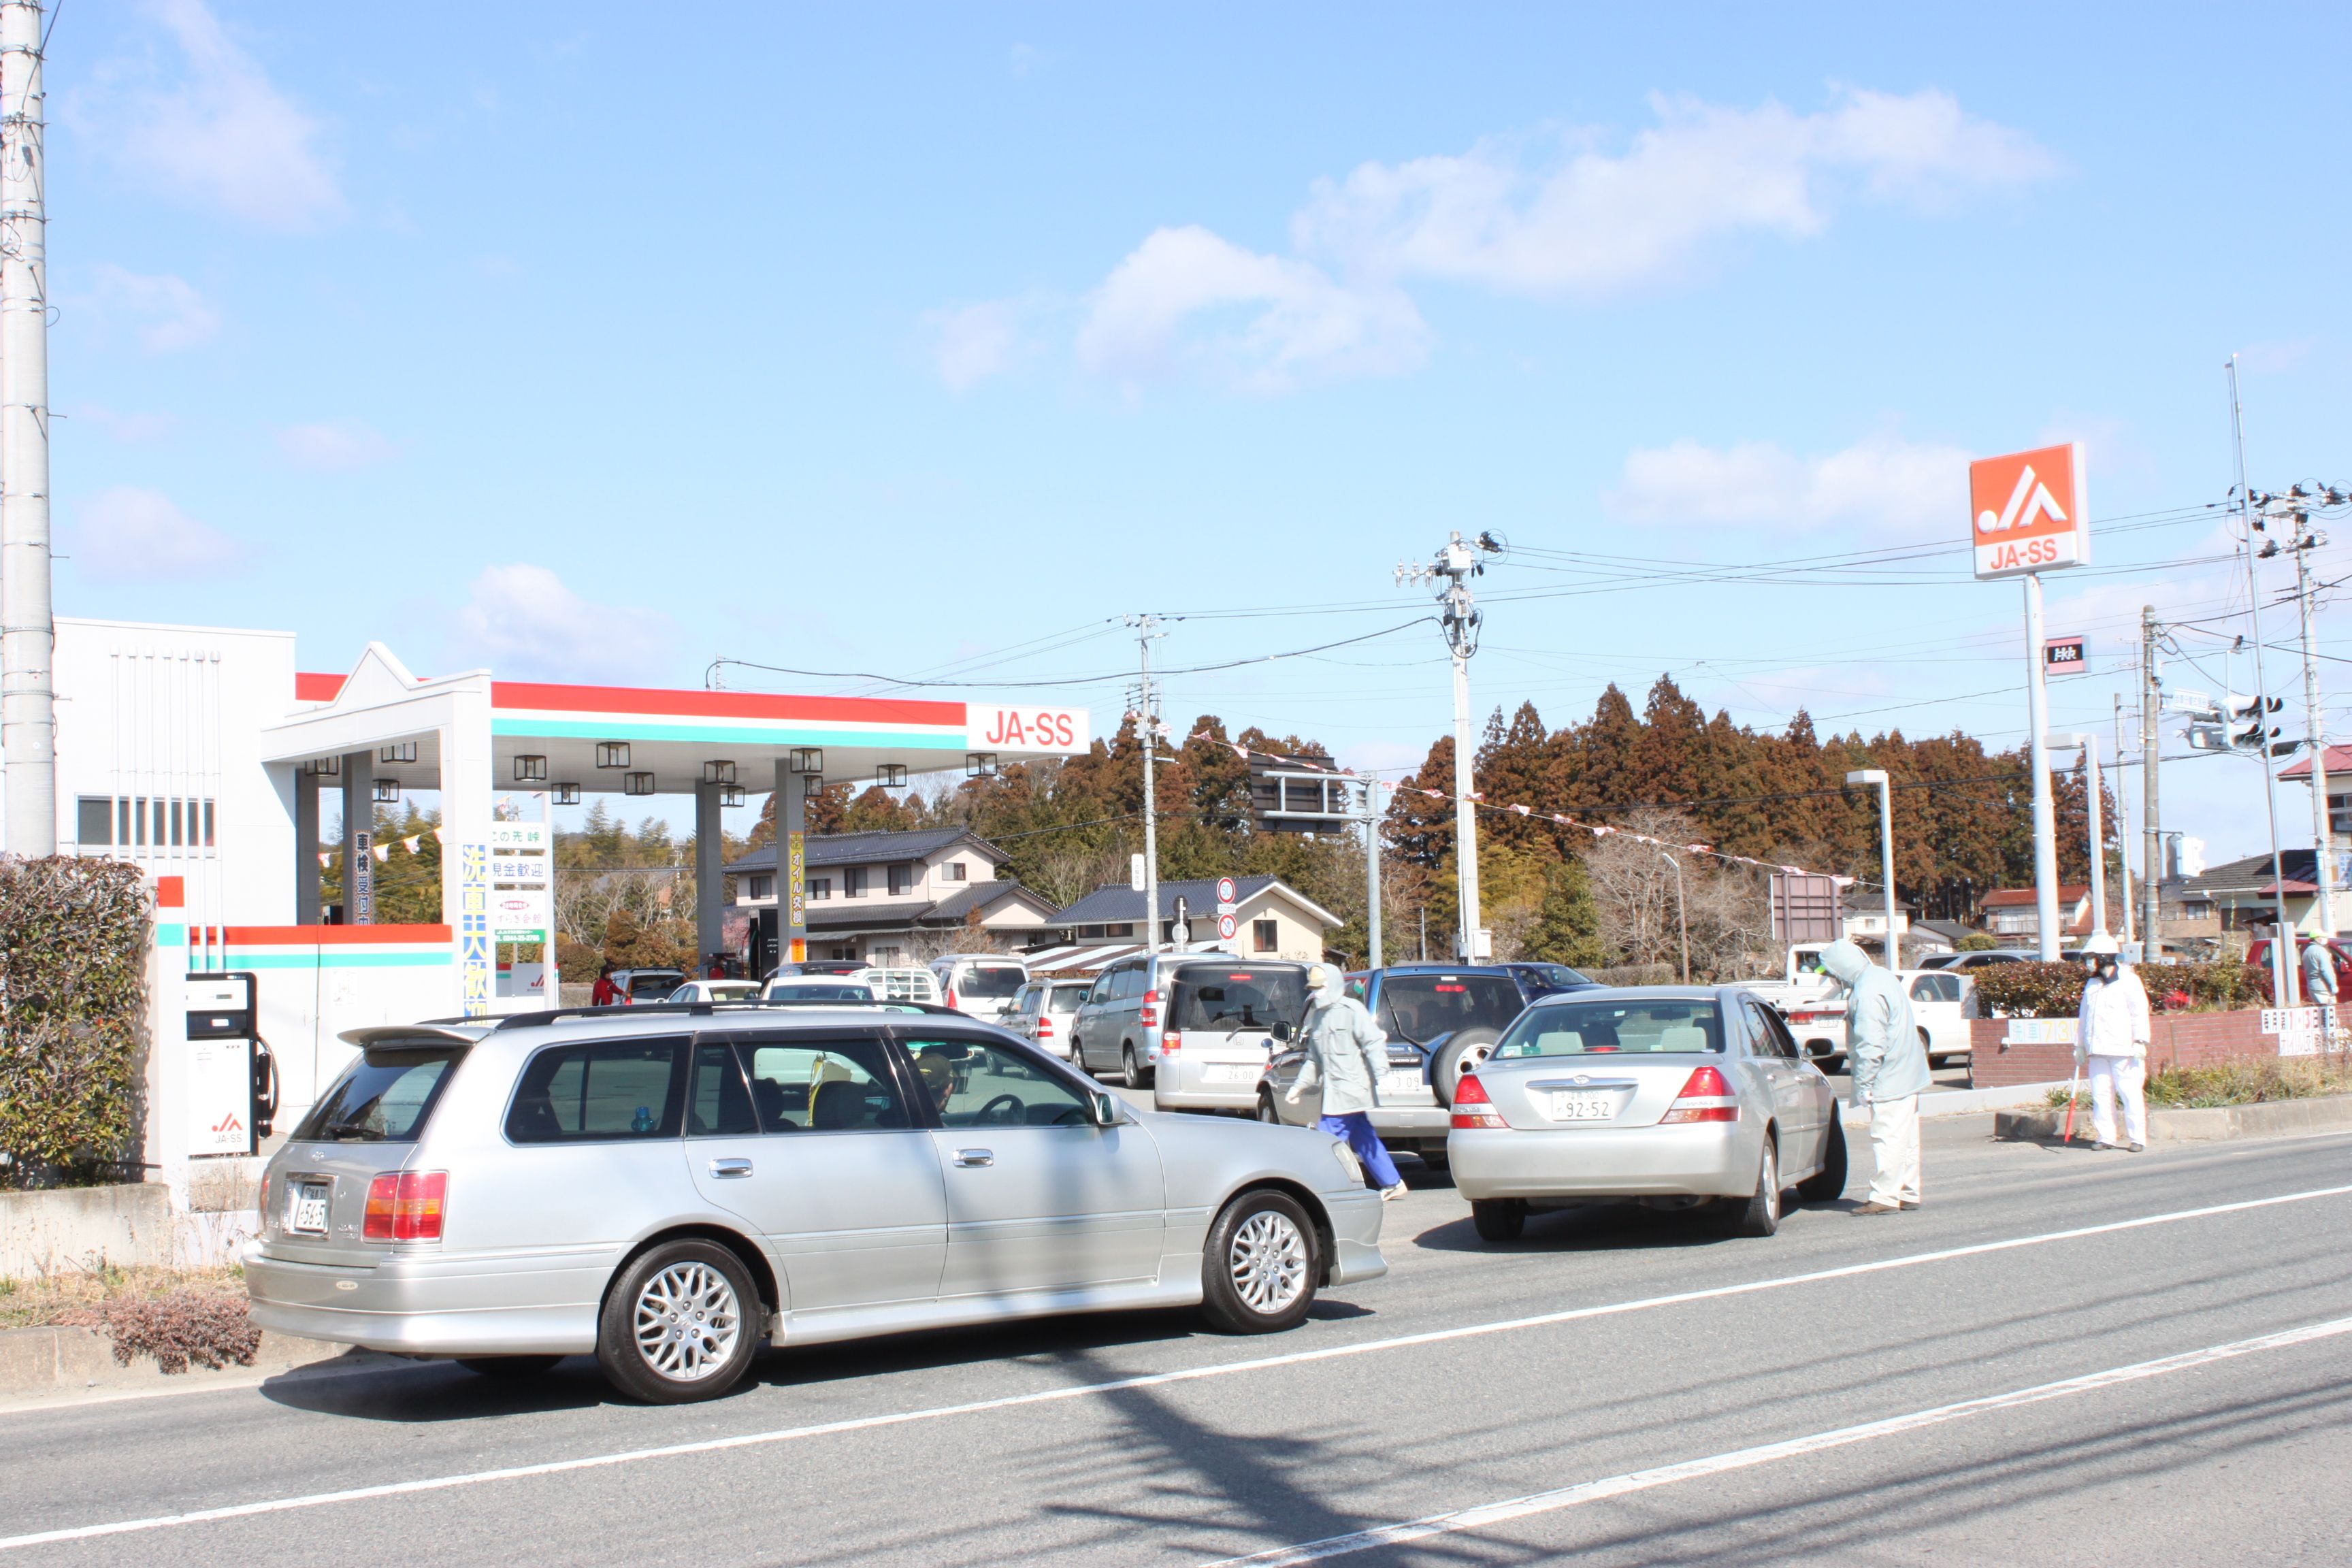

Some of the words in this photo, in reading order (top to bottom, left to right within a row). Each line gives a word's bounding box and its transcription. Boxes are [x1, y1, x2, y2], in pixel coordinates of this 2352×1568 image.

[1991, 538, 2057, 569] JA-SS
[986, 710, 1074, 747] JA-SS
[1221, 885, 1231, 896] 50
[1566, 1101, 1609, 1117] 92-52
[215, 1133, 242, 1143] JA-SS
